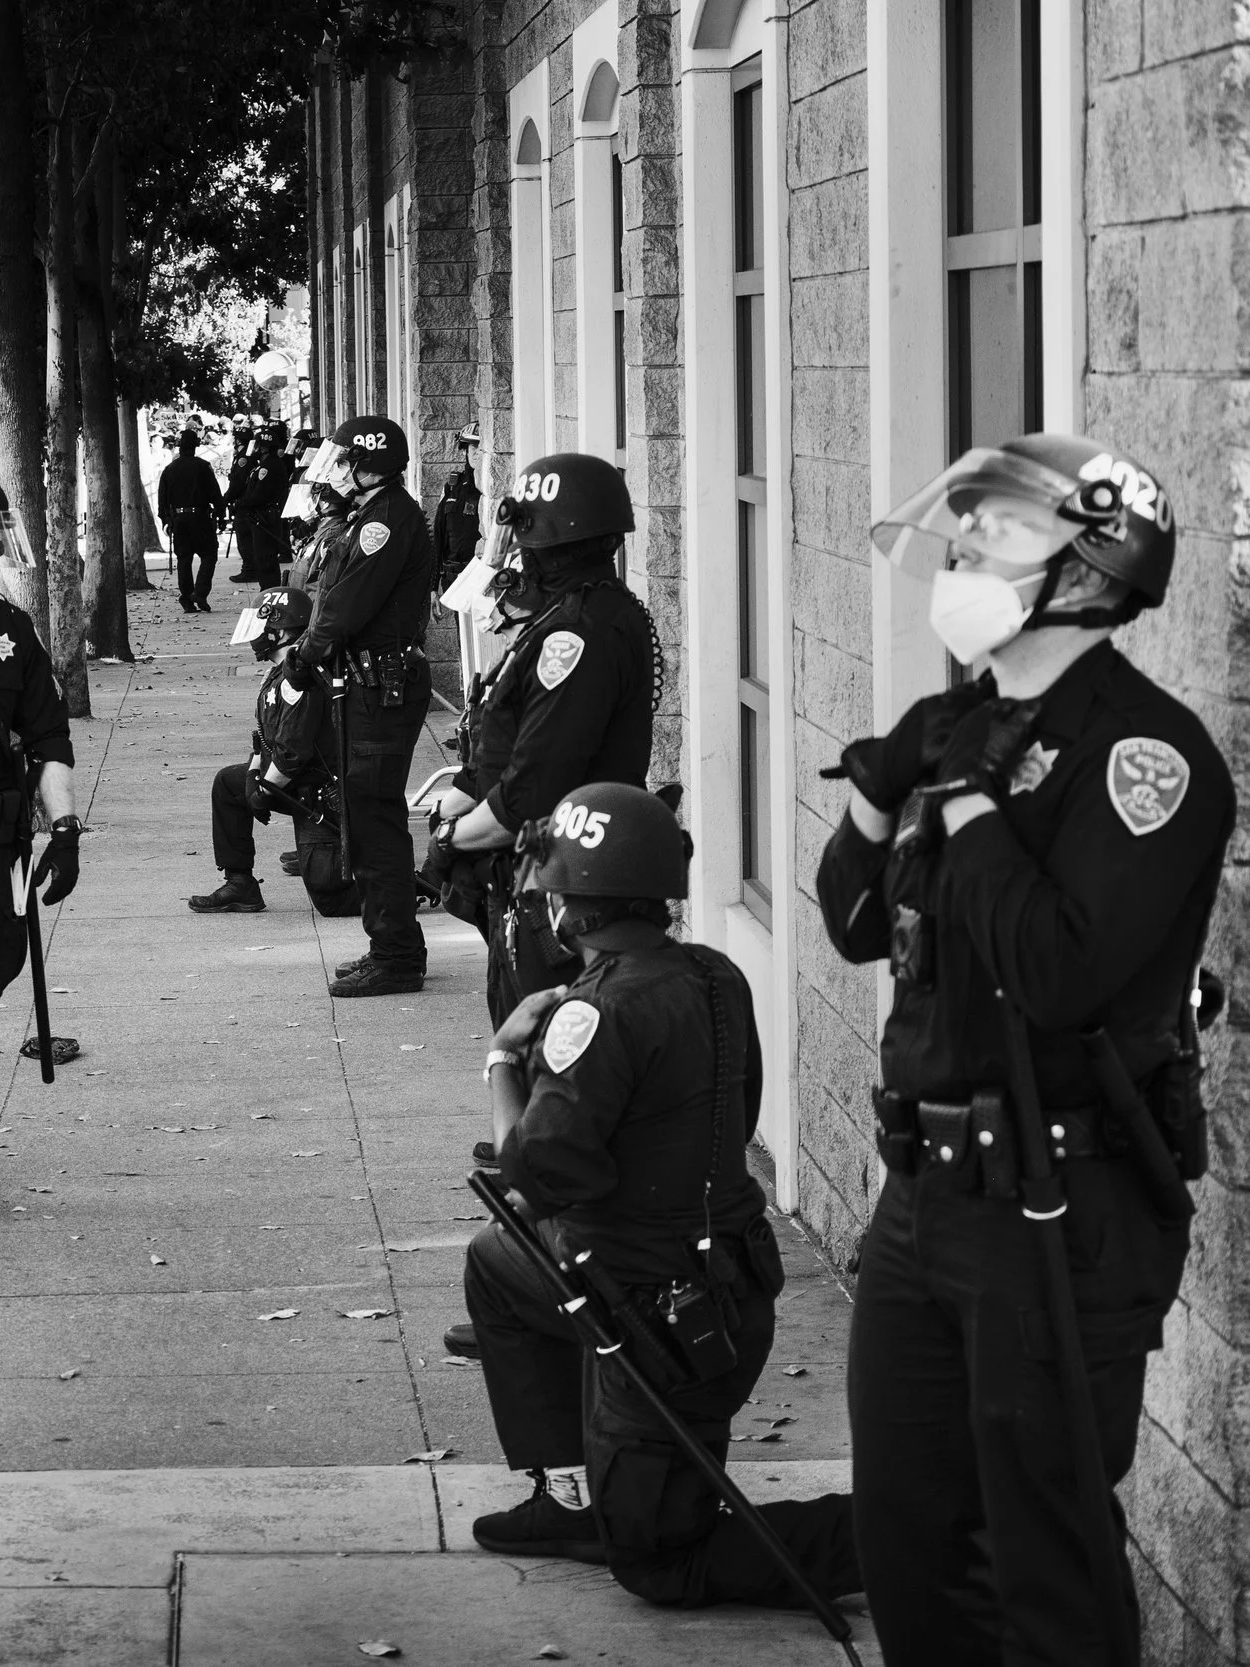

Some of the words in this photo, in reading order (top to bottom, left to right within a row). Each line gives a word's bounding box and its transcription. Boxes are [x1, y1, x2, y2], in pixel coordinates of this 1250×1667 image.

[353, 432, 387, 450] 982
[262, 592, 289, 606] 274
[553, 801, 612, 849] 905
